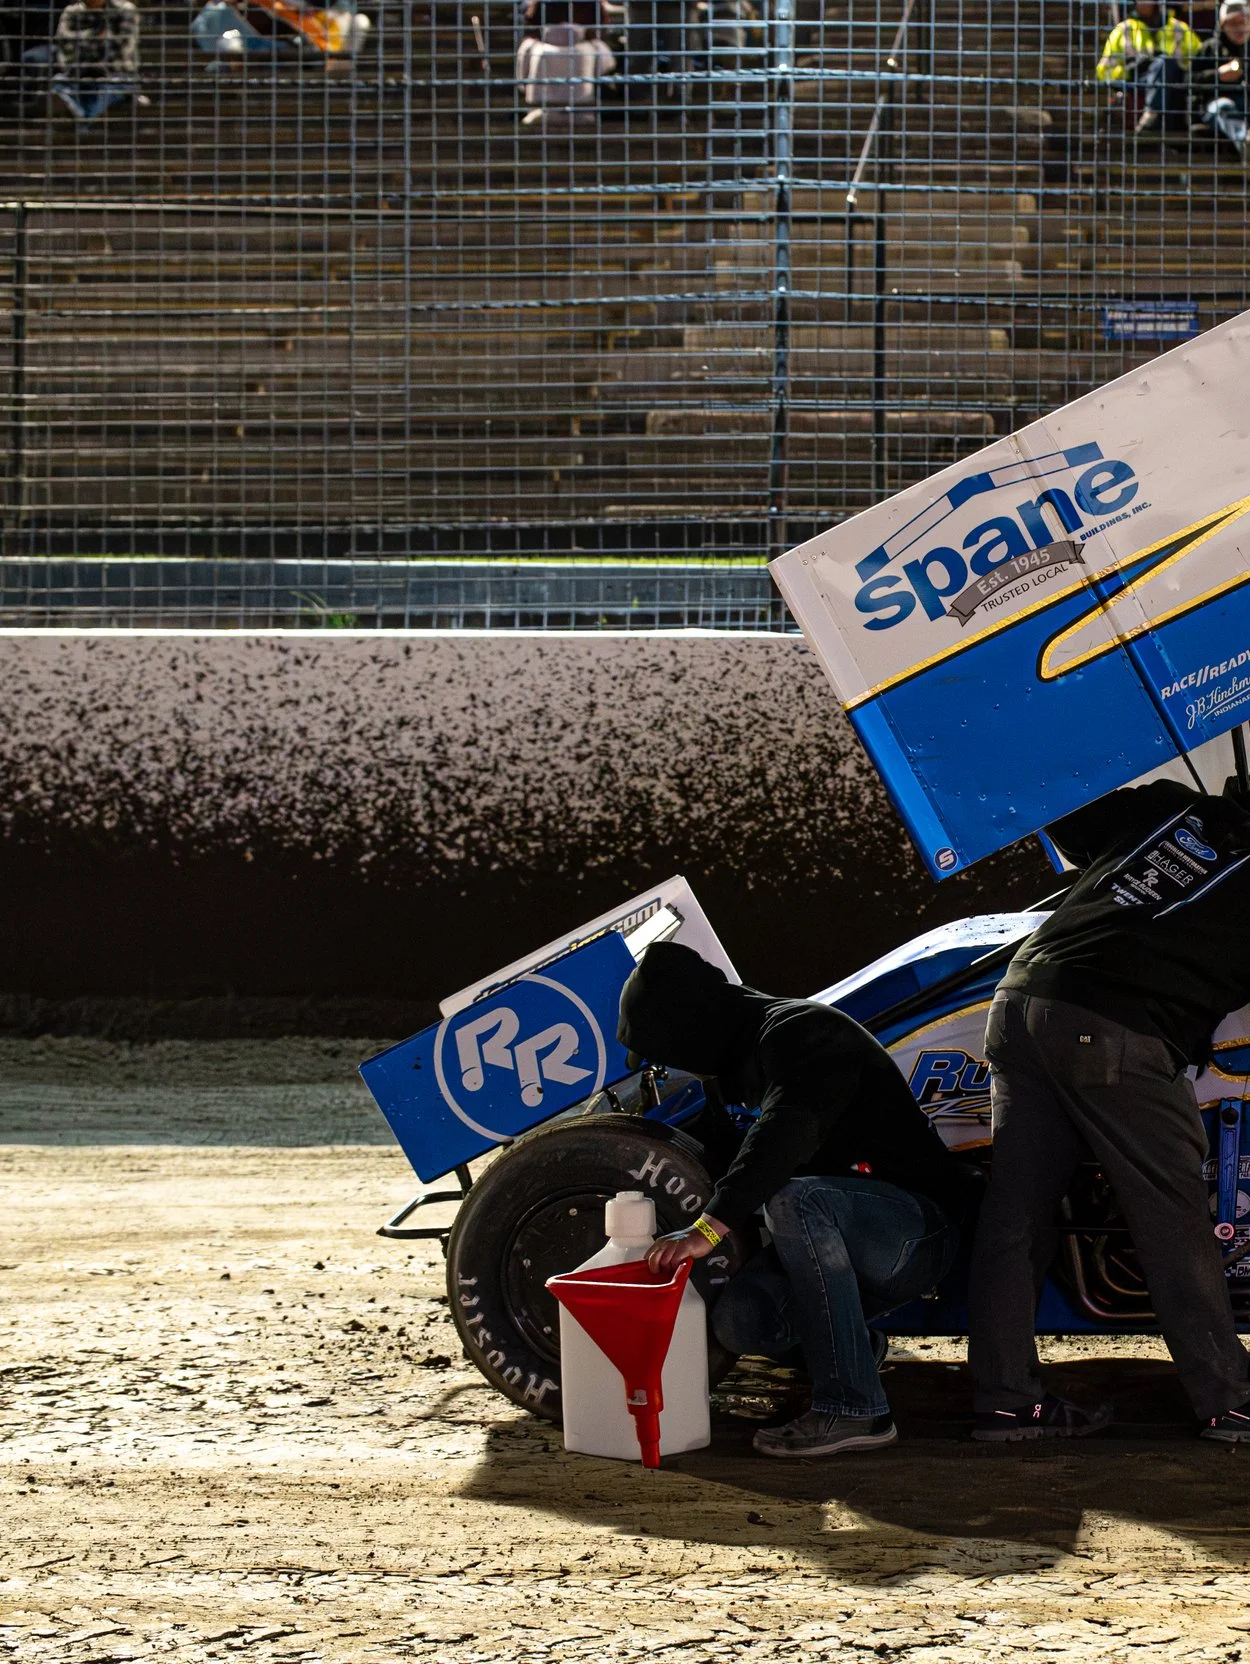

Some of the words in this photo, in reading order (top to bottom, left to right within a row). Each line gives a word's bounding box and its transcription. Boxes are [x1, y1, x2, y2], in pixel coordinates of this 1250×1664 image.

[1080, 510, 1132, 541] BUILDINGS,
[1132, 501, 1152, 515] INC.
[855, 458, 1138, 631] spane
[976, 570, 1009, 596] Est.
[1011, 548, 1051, 575] 1945
[981, 581, 1031, 613] TRUSTED
[1033, 563, 1069, 587] LOCAL
[1178, 836, 1211, 857] Ford
[1155, 853, 1195, 885] HAGER
[1110, 881, 1145, 905] TWENT
